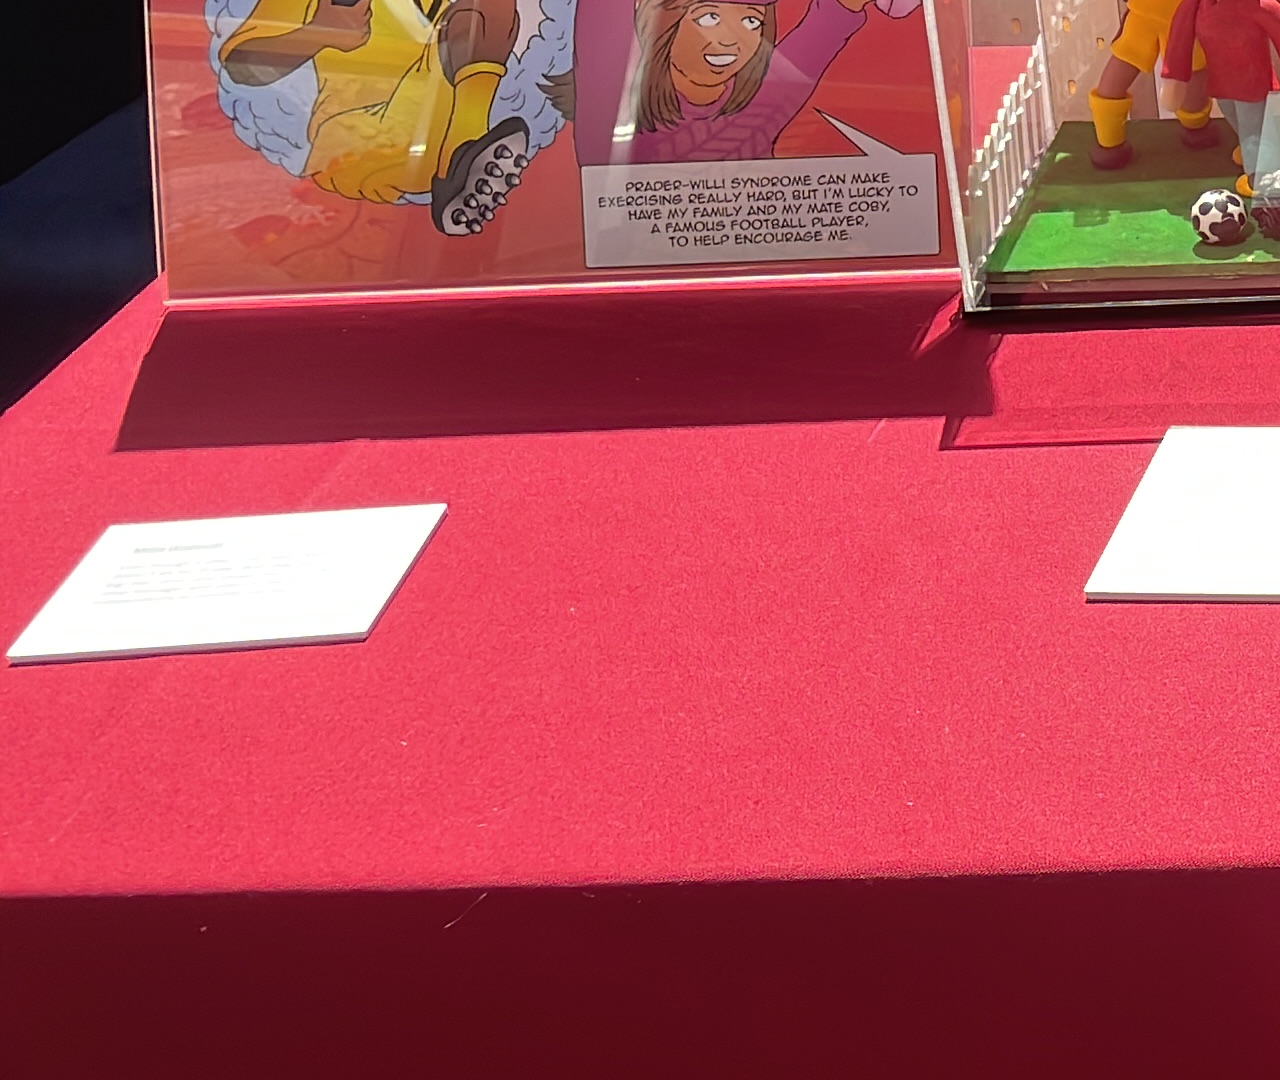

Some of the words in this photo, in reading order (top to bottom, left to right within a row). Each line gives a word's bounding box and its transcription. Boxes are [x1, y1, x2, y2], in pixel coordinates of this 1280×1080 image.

[626, 178, 726, 192] PRADER-WILLI
[731, 175, 812, 189] SYNDROME
[817, 174, 846, 186] CAN
[850, 172, 890, 184] MAKE
[598, 194, 683, 208] EXERCISING
[688, 191, 742, 204] REALLY
[792, 189, 819, 200] BUT
[824, 187, 844, 199] I'M
[848, 186, 894, 198] LUCKY
[898, 185, 918, 196] TO
[628, 208, 662, 220] HAVE
[667, 207, 688, 220] MY
[693, 205, 742, 218] FAMILY
[746, 204, 777, 217] AND
[781, 203, 802, 217] MY
[807, 202, 843, 214] MATE
[650, 223, 661, 234] A
[665, 220, 726, 233] FAMOUS
[730, 218, 806, 231] FOOTBALL
[668, 236, 688, 248] TO
[694, 234, 730, 246] HELP
[734, 230, 823, 245] ENCOURAGE
